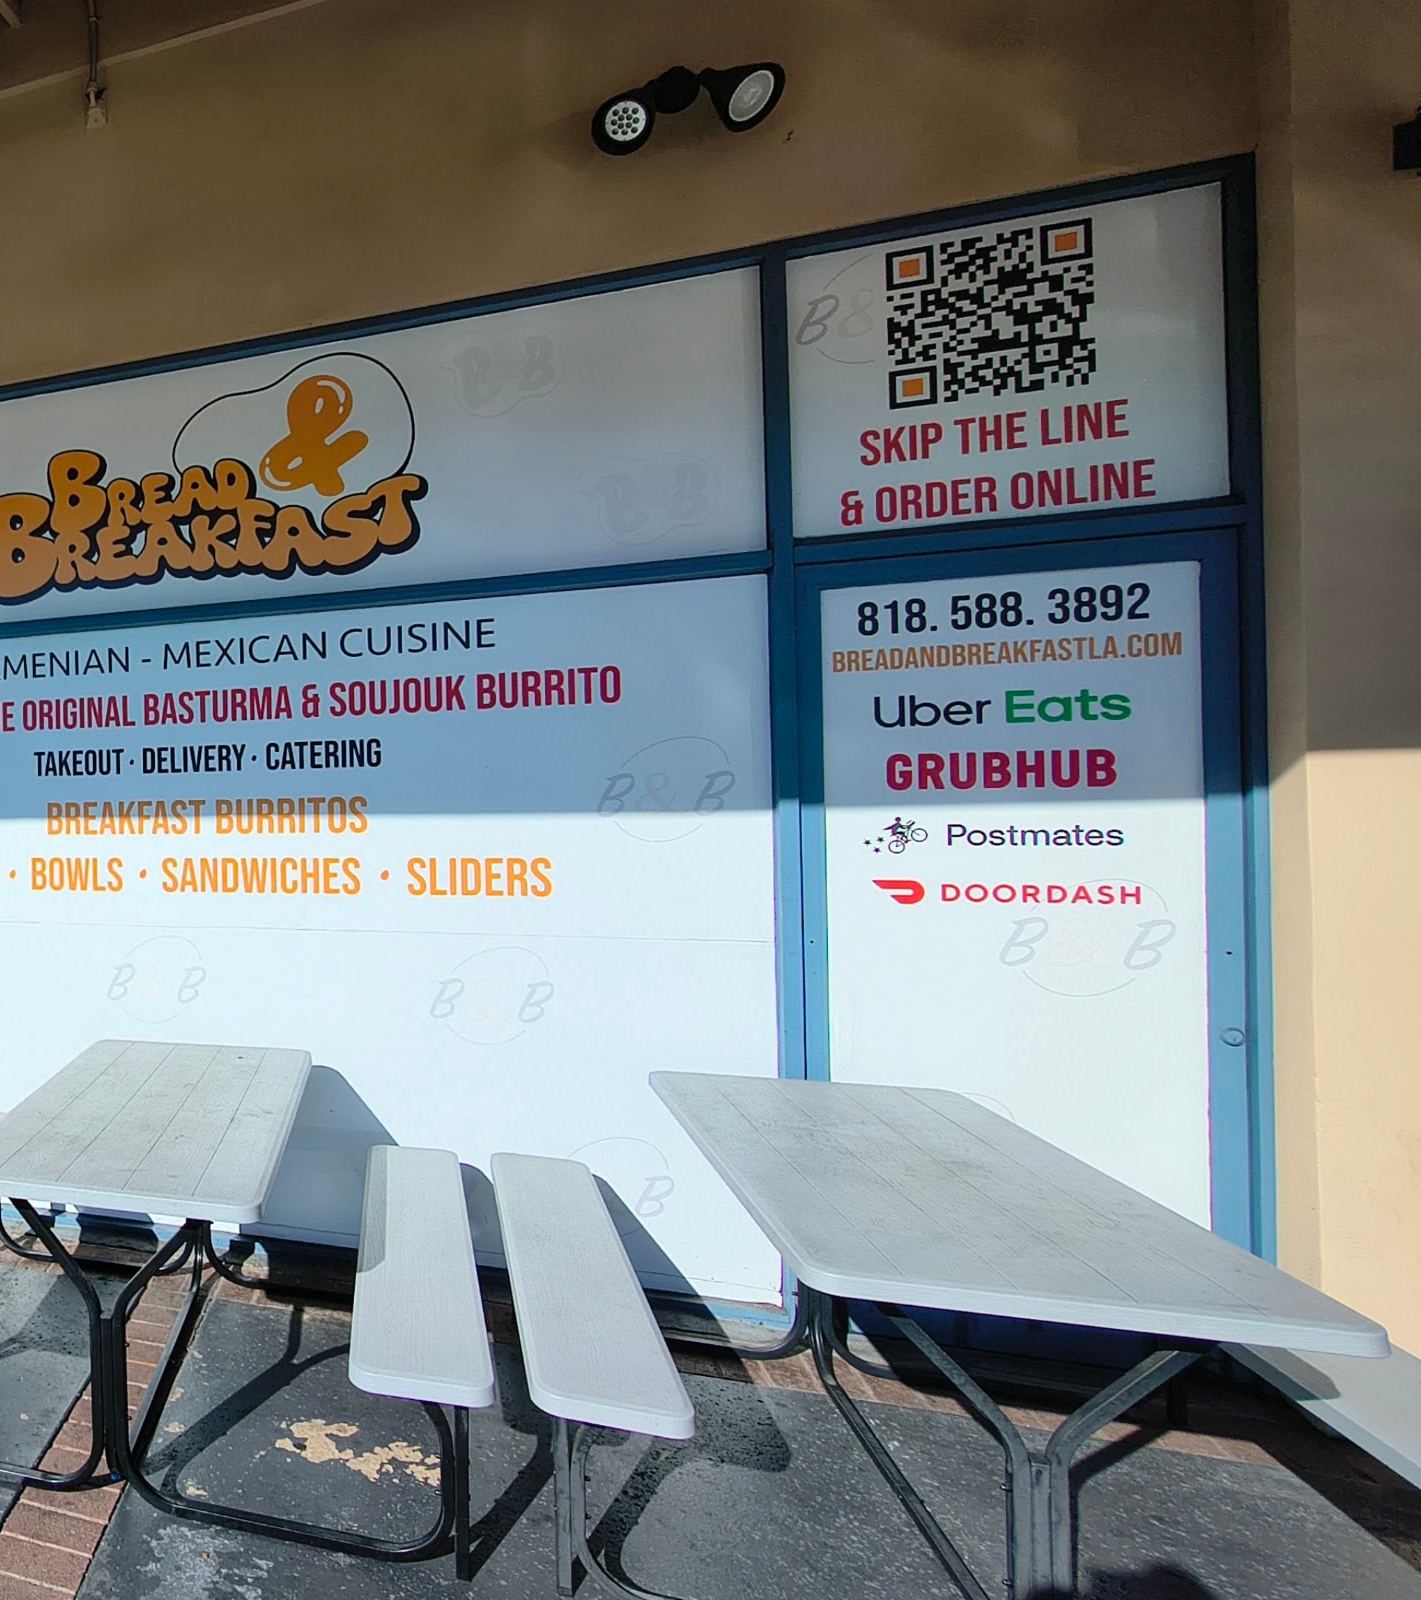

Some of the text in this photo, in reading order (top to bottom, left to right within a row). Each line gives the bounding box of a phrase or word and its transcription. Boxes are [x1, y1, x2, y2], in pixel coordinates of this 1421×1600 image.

[860, 398, 1129, 467] SKIP THE LINE
[46, 374, 369, 535] BREAD &
[841, 458, 1157, 527] & ORDER ONLINE
[856, 581, 1151, 637] 818. 588. 3892
[163, 630, 328, 671] MEXICAN
[339, 617, 497, 659] CUISINE
[831, 631, 1183, 674] BREADANDBREAKFASTLA.COM
[22, 695, 136, 731] ORIGINAL
[143, 685, 293, 726] BASTURMA
[302, 684, 320, 719] &
[329, 675, 467, 717] SOUJOUK
[477, 665, 622, 711] BURRITO
[873, 688, 1133, 729] Uber Eats
[34, 737, 382, 778] TAKEOUT DELIVERY CATERING
[885, 748, 1118, 791] GRUBHUB
[47, 795, 369, 836] BREAKFAST BURRITOS
[946, 823, 1126, 848] Postmates
[31, 857, 124, 892] BOWLS
[161, 857, 362, 895] SANDWICHES
[406, 856, 554, 898] SLIDERS
[940, 883, 1143, 906] DOORDASH
